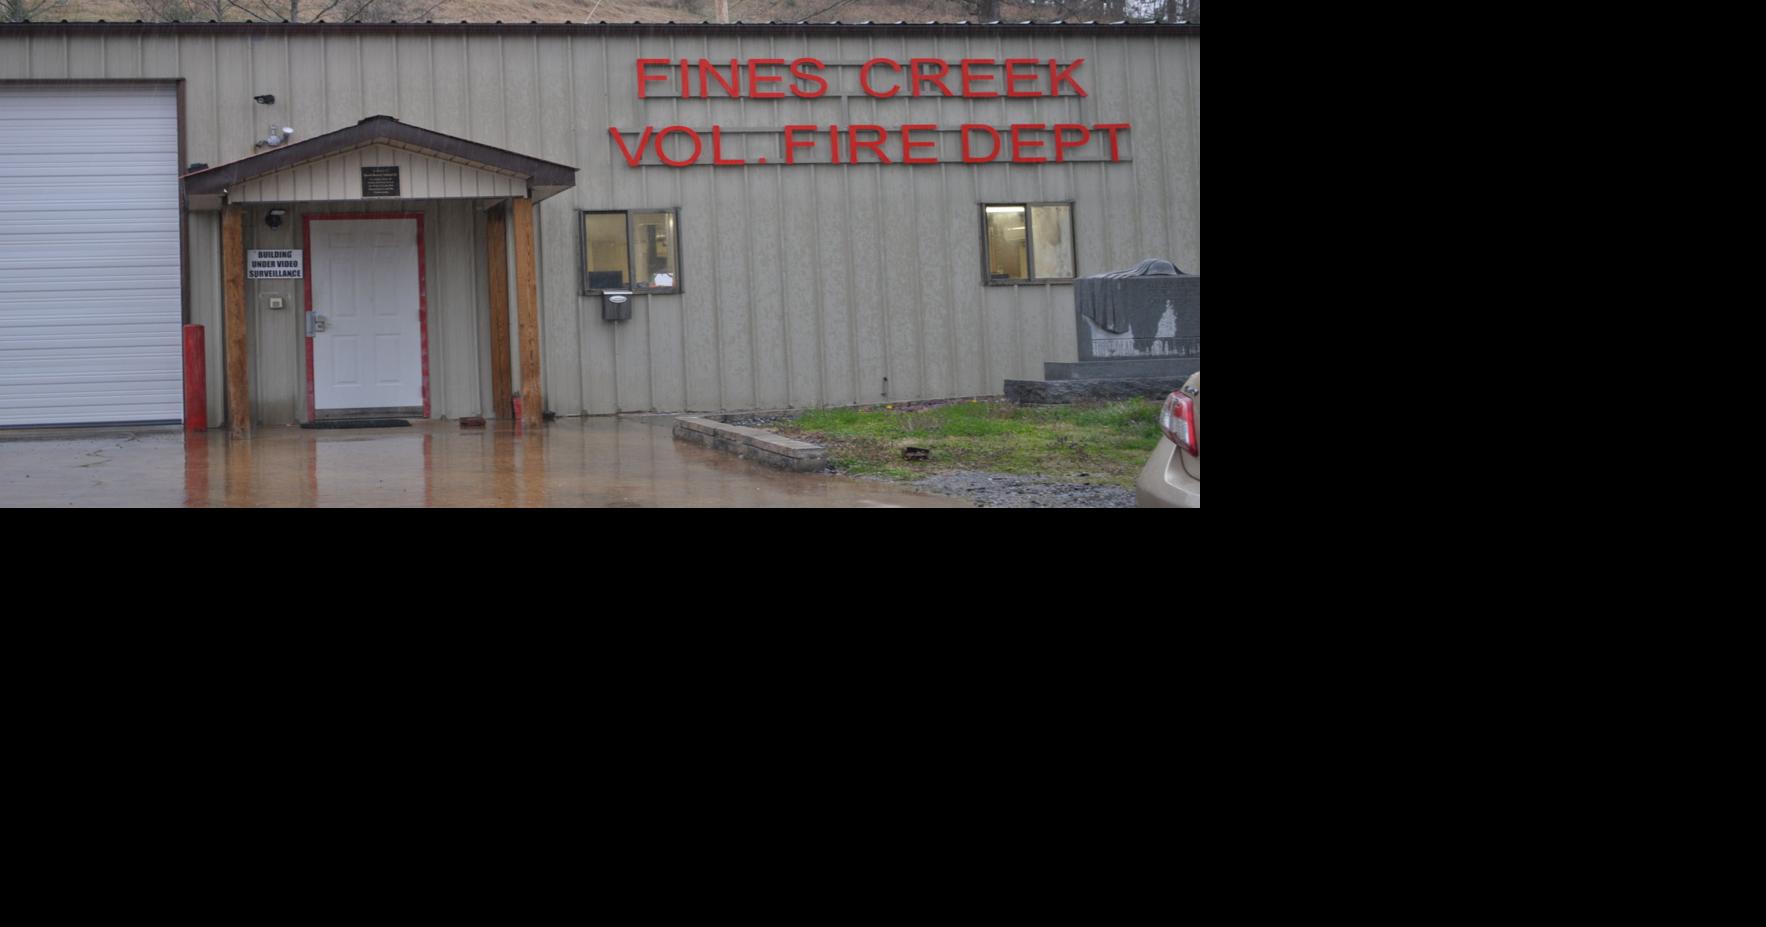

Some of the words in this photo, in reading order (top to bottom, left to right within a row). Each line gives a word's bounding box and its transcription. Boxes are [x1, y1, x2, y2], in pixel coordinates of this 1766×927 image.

[636, 58, 829, 99] FINES
[859, 57, 1088, 98] CREEK
[608, 124, 766, 167] VOL.
[784, 124, 938, 166] FIRE
[960, 123, 1131, 164] DEPT
[249, 270, 301, 278] SURVEILLANCE
[251, 260, 276, 268] UNDER
[276, 260, 298, 268] VIDEO
